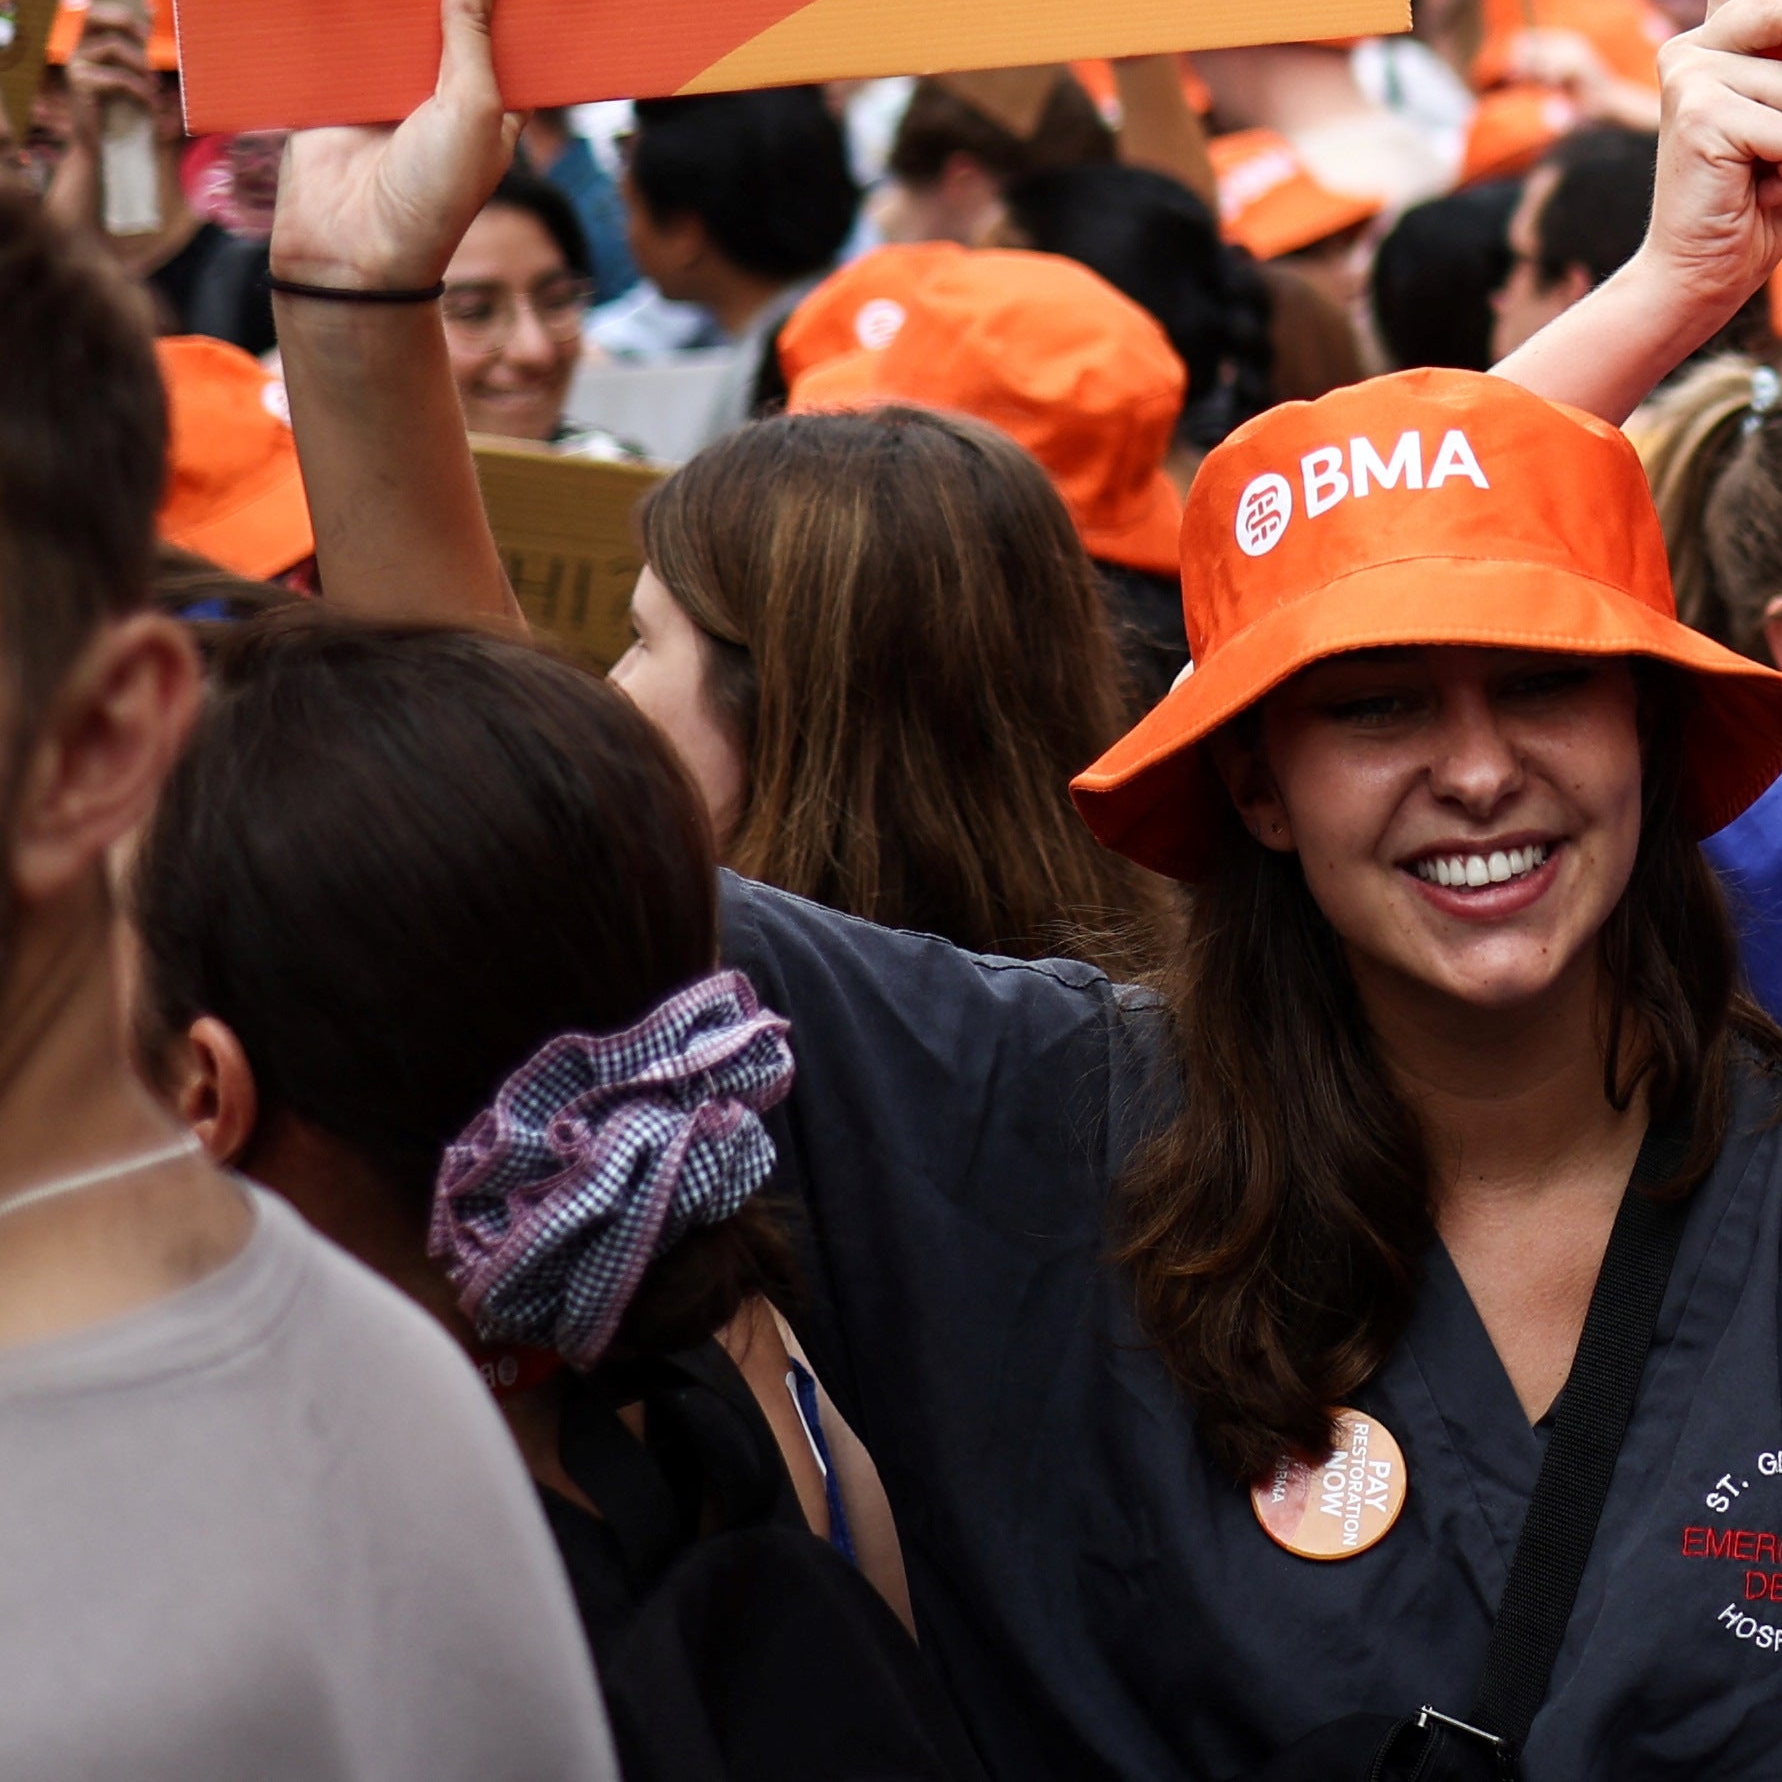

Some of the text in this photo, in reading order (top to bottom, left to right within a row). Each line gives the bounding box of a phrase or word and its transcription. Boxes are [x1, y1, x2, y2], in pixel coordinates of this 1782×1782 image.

[1299, 429, 1489, 519] BMA
[1319, 1450, 1349, 1518] NOW
[1342, 1423, 1370, 1546] RESTORATION
[1364, 1460, 1392, 1513] PAY
[1705, 1473, 1749, 1513] ST.
